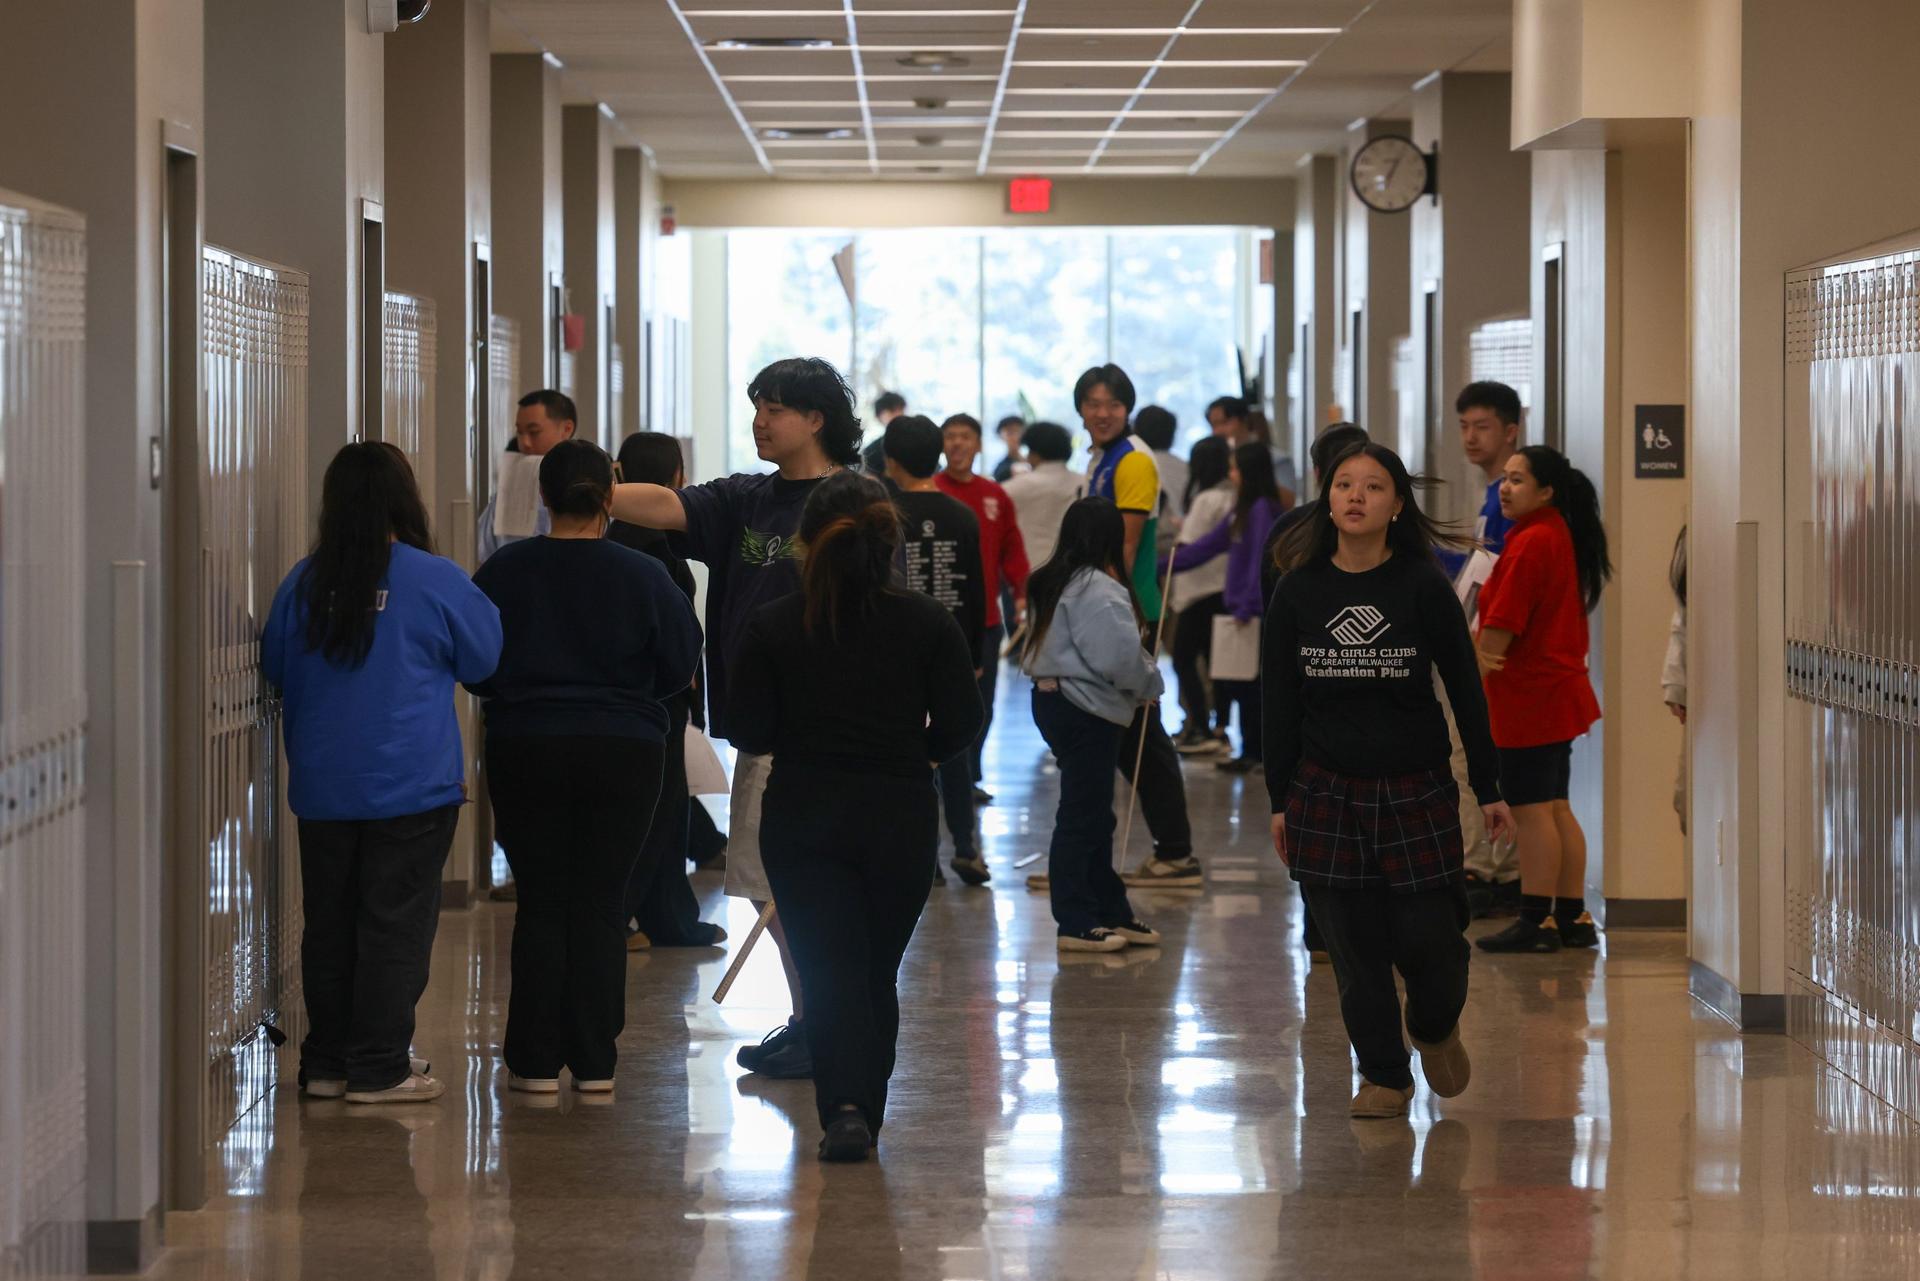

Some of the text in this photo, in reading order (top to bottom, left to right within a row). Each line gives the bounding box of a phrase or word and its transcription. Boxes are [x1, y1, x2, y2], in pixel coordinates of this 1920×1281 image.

[1640, 462, 1678, 470] WOMEN
[1300, 647, 1417, 657] BOYS & GIRLS CLUBS
[1311, 658, 1403, 666] OF GREATER MILWAUKEE
[1305, 665, 1410, 678] Graduation Plus
